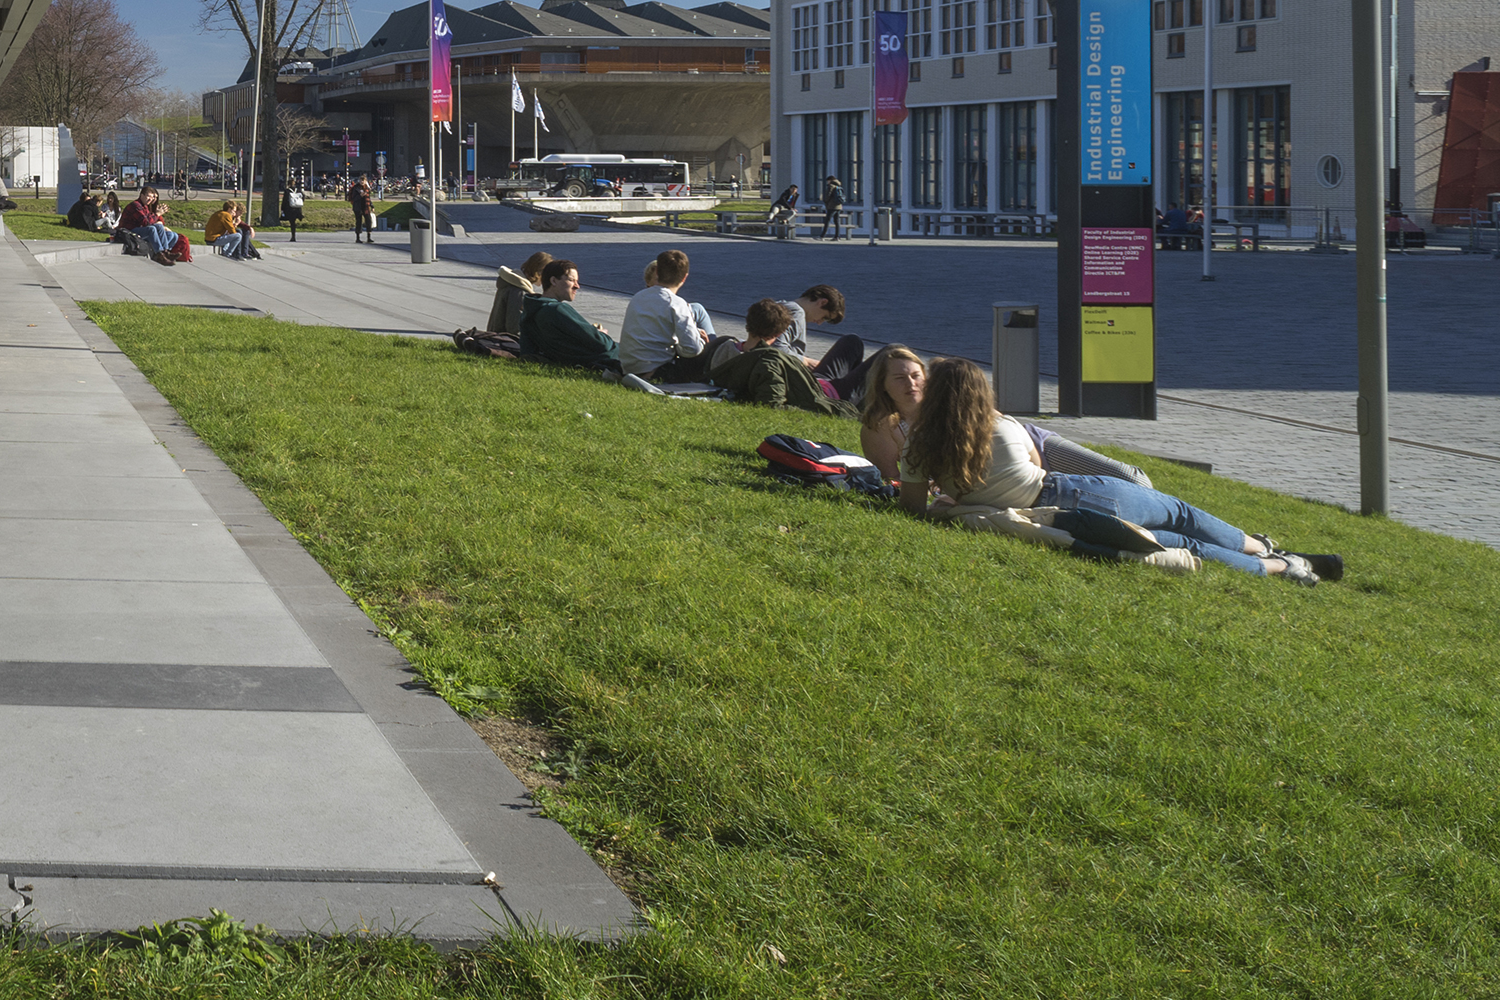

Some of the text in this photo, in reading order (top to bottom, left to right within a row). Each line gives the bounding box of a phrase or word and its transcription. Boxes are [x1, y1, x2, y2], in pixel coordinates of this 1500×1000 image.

[880, 34, 901, 52] 50
[1086, 11, 1105, 180] Industrial Design
[1107, 65, 1126, 180] Engineering
